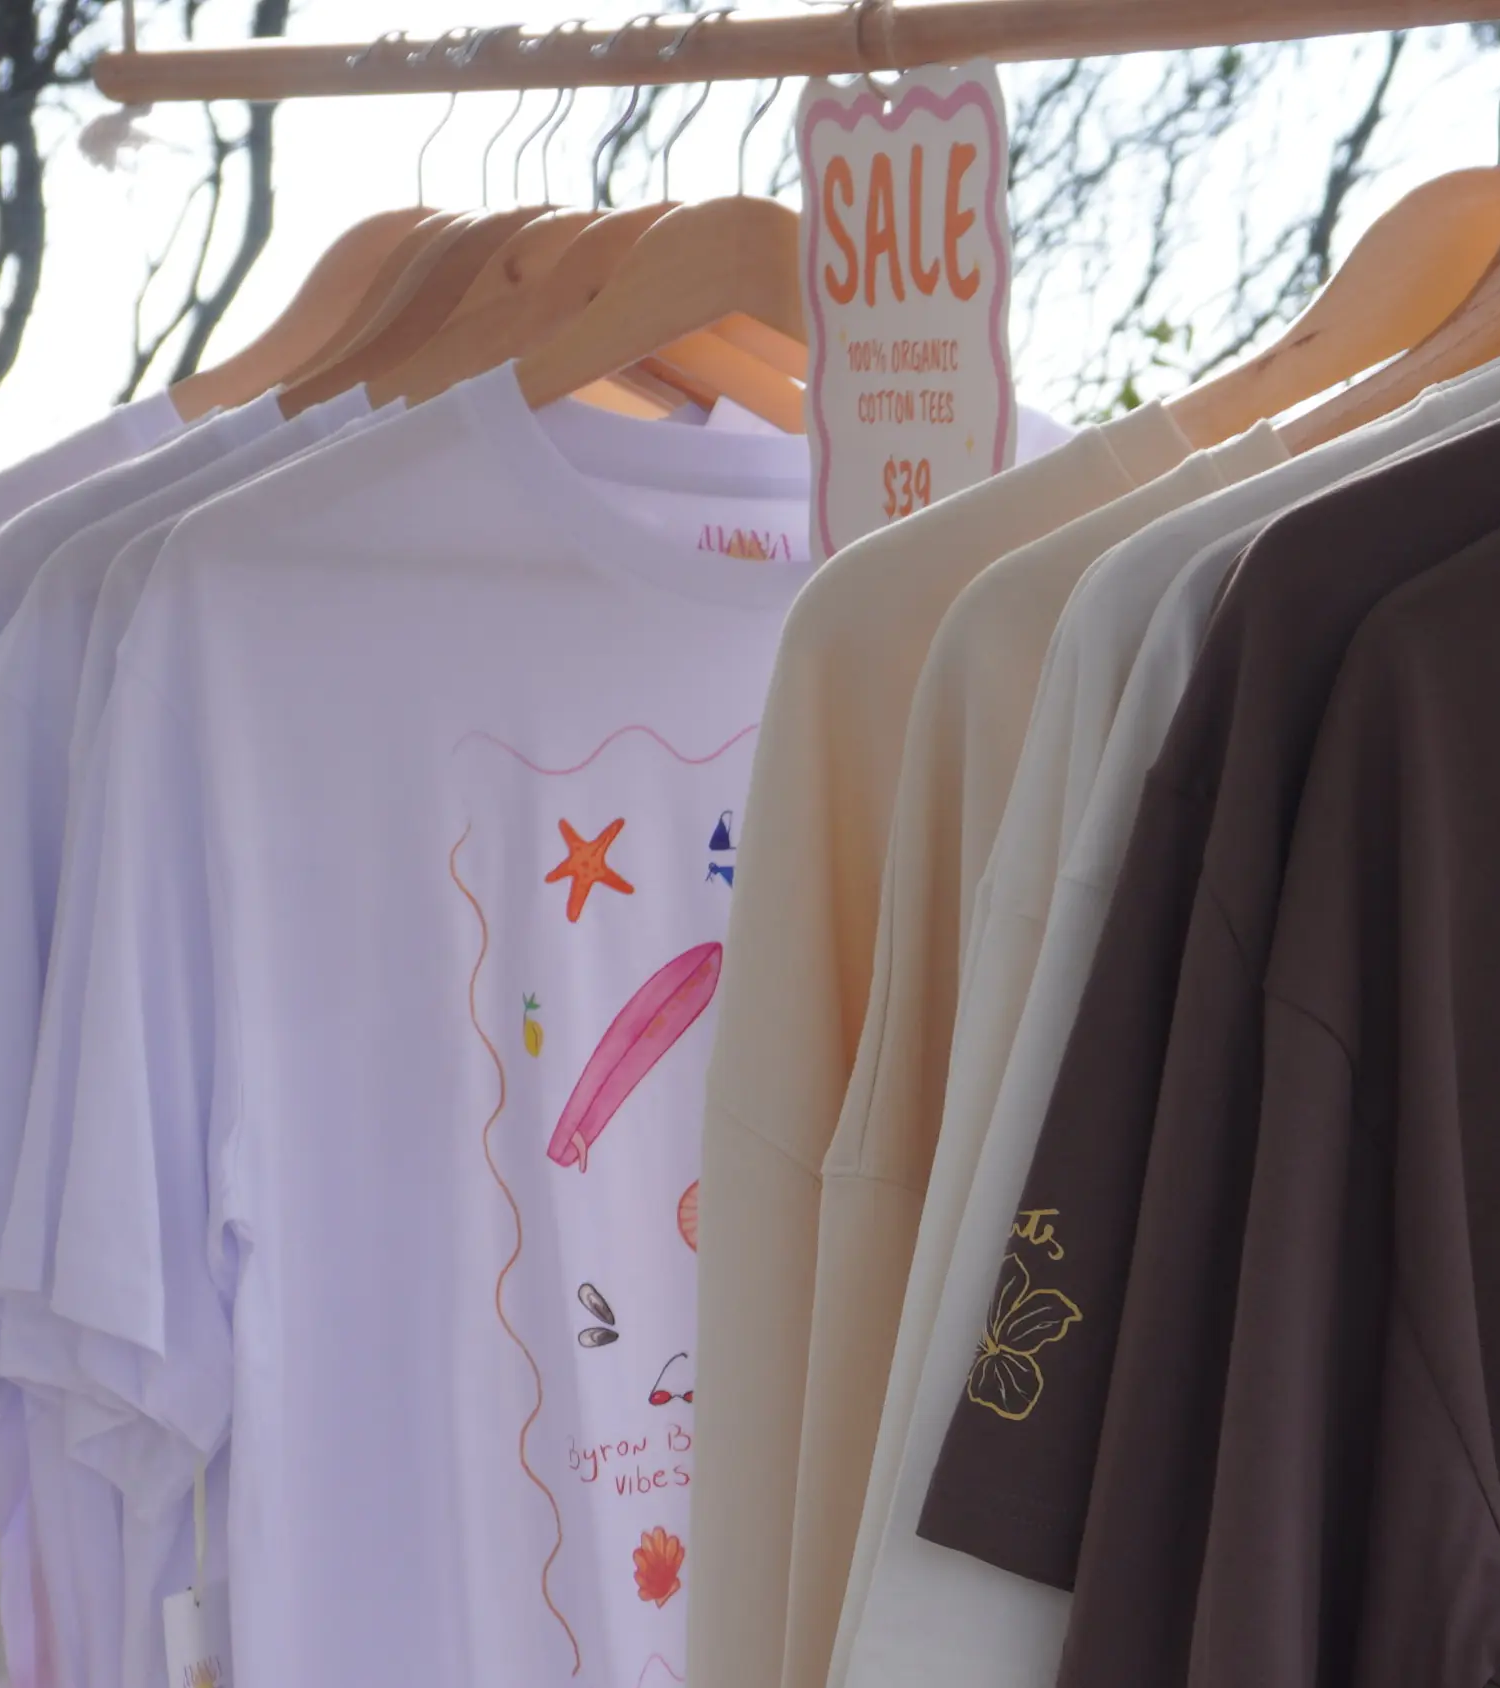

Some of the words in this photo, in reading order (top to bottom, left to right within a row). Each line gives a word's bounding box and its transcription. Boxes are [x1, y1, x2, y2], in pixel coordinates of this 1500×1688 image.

[824, 142, 980, 308] SALE
[847, 339, 887, 373] 100%
[891, 338, 958, 373] ORGANIC
[858, 389, 915, 425] COTTON
[919, 389, 954, 425] TEES
[882, 454, 931, 521] $39
